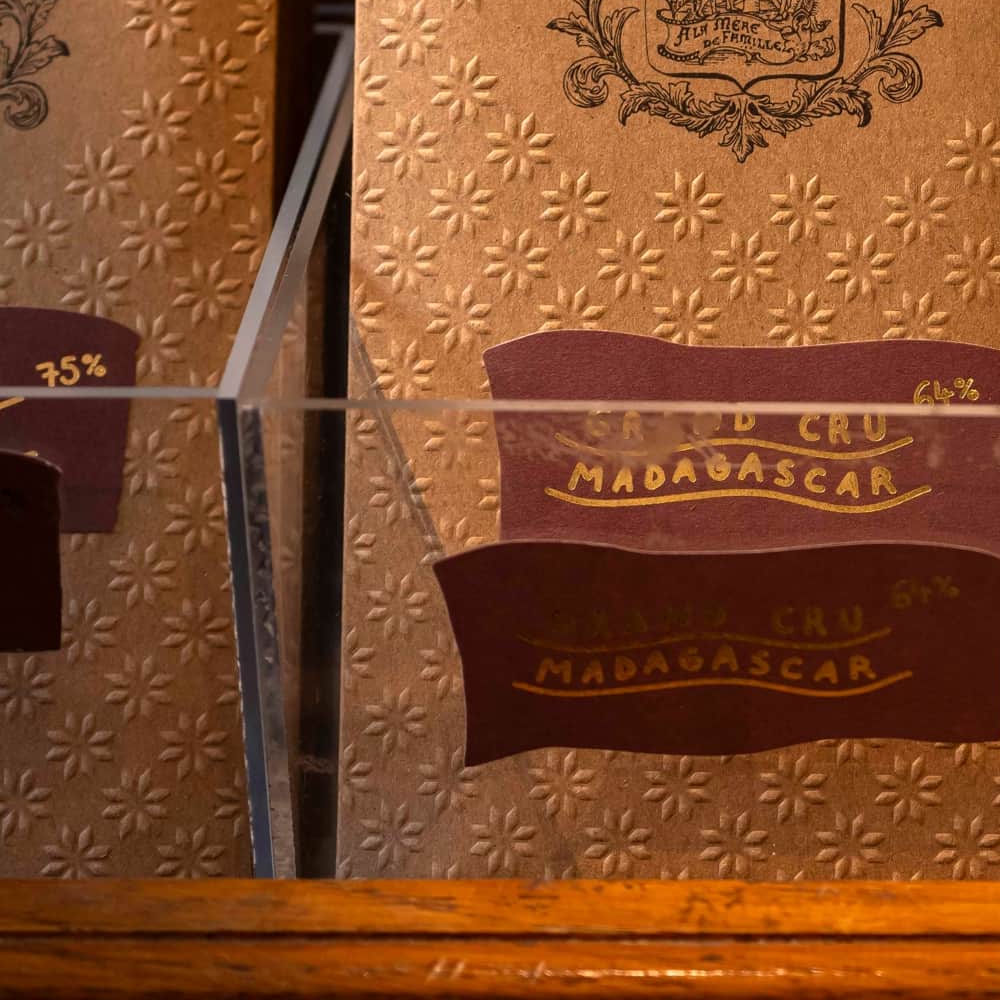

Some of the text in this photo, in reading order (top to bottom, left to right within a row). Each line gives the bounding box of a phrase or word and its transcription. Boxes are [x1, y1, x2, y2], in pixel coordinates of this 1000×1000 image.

[722, 31, 781, 50] FAMILLE
[35, 353, 108, 387] 75%
[913, 376, 980, 408] 64%
[799, 412, 887, 445] CRU
[568, 452, 896, 498] MADAGASCAR
[769, 602, 866, 637] CRU
[534, 644, 876, 684] MADAGASCAR
